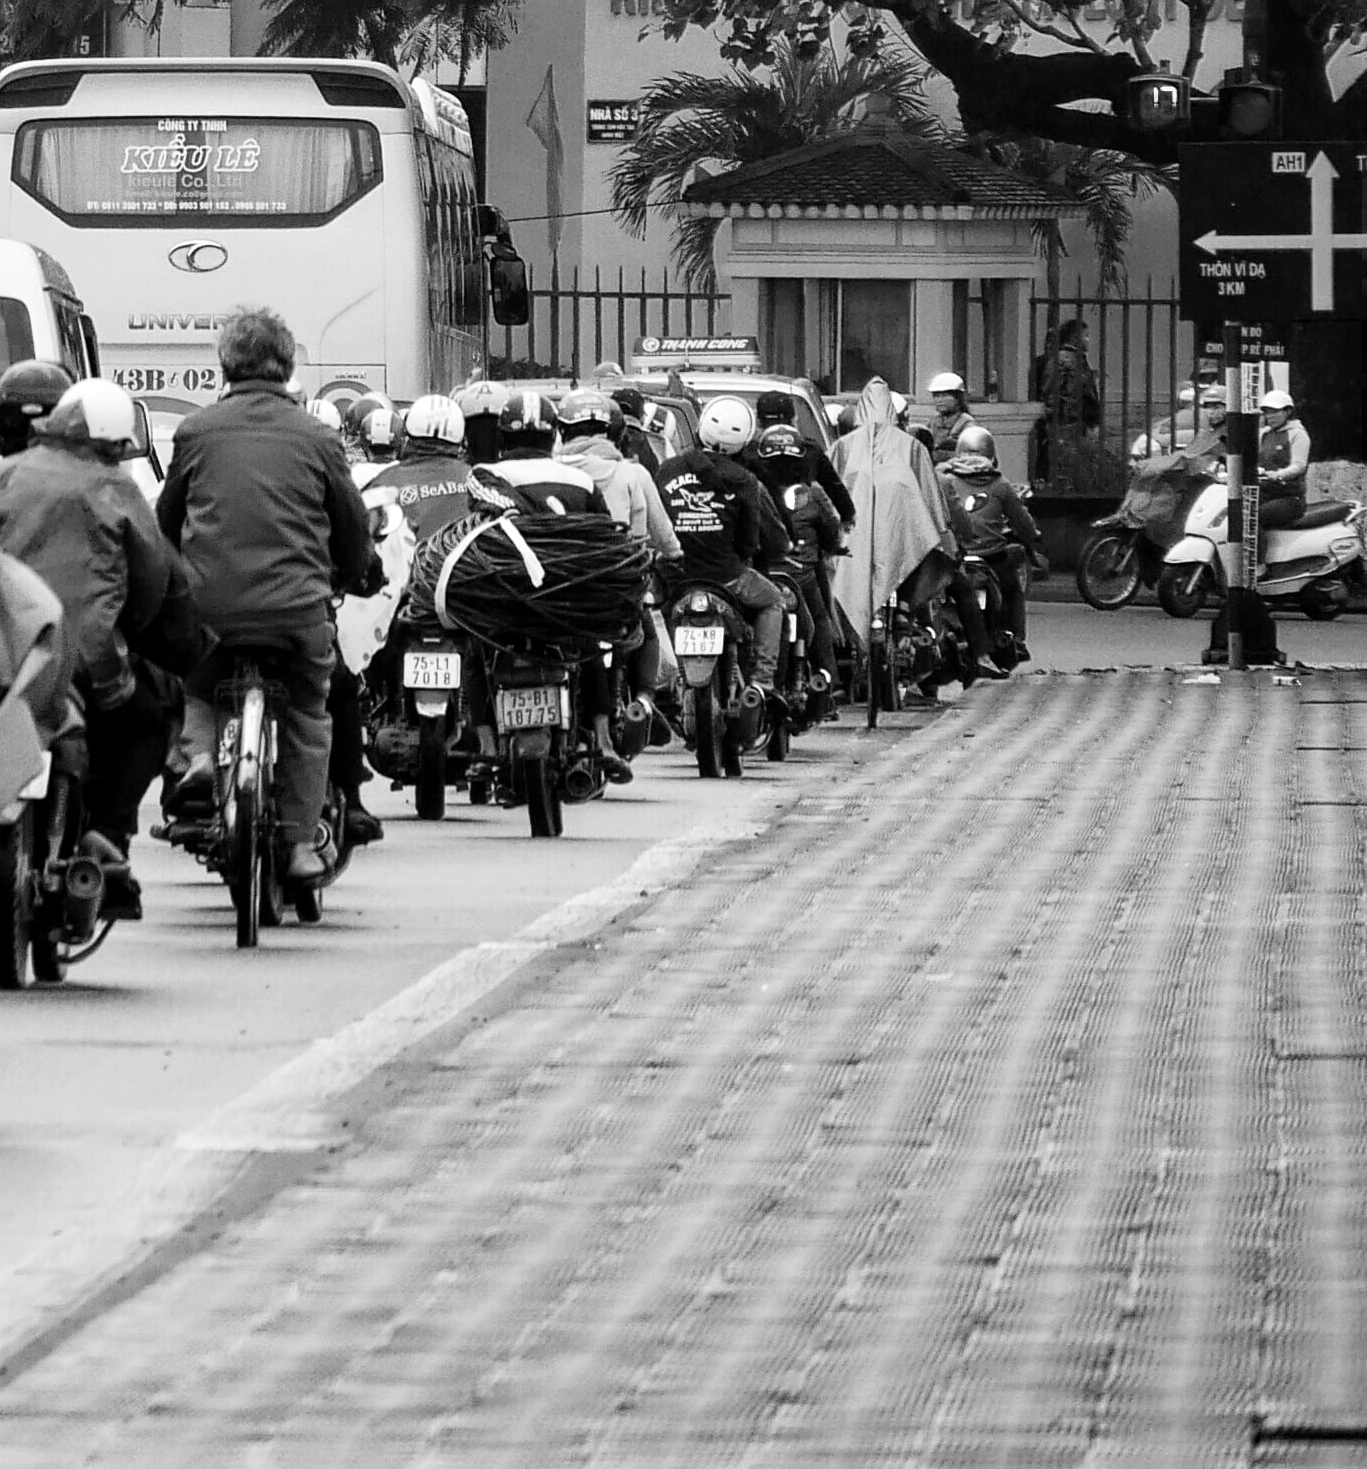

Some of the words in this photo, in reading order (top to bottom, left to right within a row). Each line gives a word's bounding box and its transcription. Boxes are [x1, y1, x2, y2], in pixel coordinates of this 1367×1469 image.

[1153, 86, 1178, 109] 17
[157, 117, 185, 132] CÔNG
[187, 119, 199, 132] TY
[201, 119, 228, 132] TNHH
[213, 137, 261, 173] LÊ
[1276, 156, 1304, 171] AH1
[1356, 155, 1367, 172] T
[1199, 260, 1232, 277] THÔN
[1249, 262, 1266, 279] DẠ
[1218, 282, 1226, 295] 3
[1226, 282, 1245, 295] KM
[413, 657, 451, 672] 75-L1
[412, 671, 452, 686] 7018
